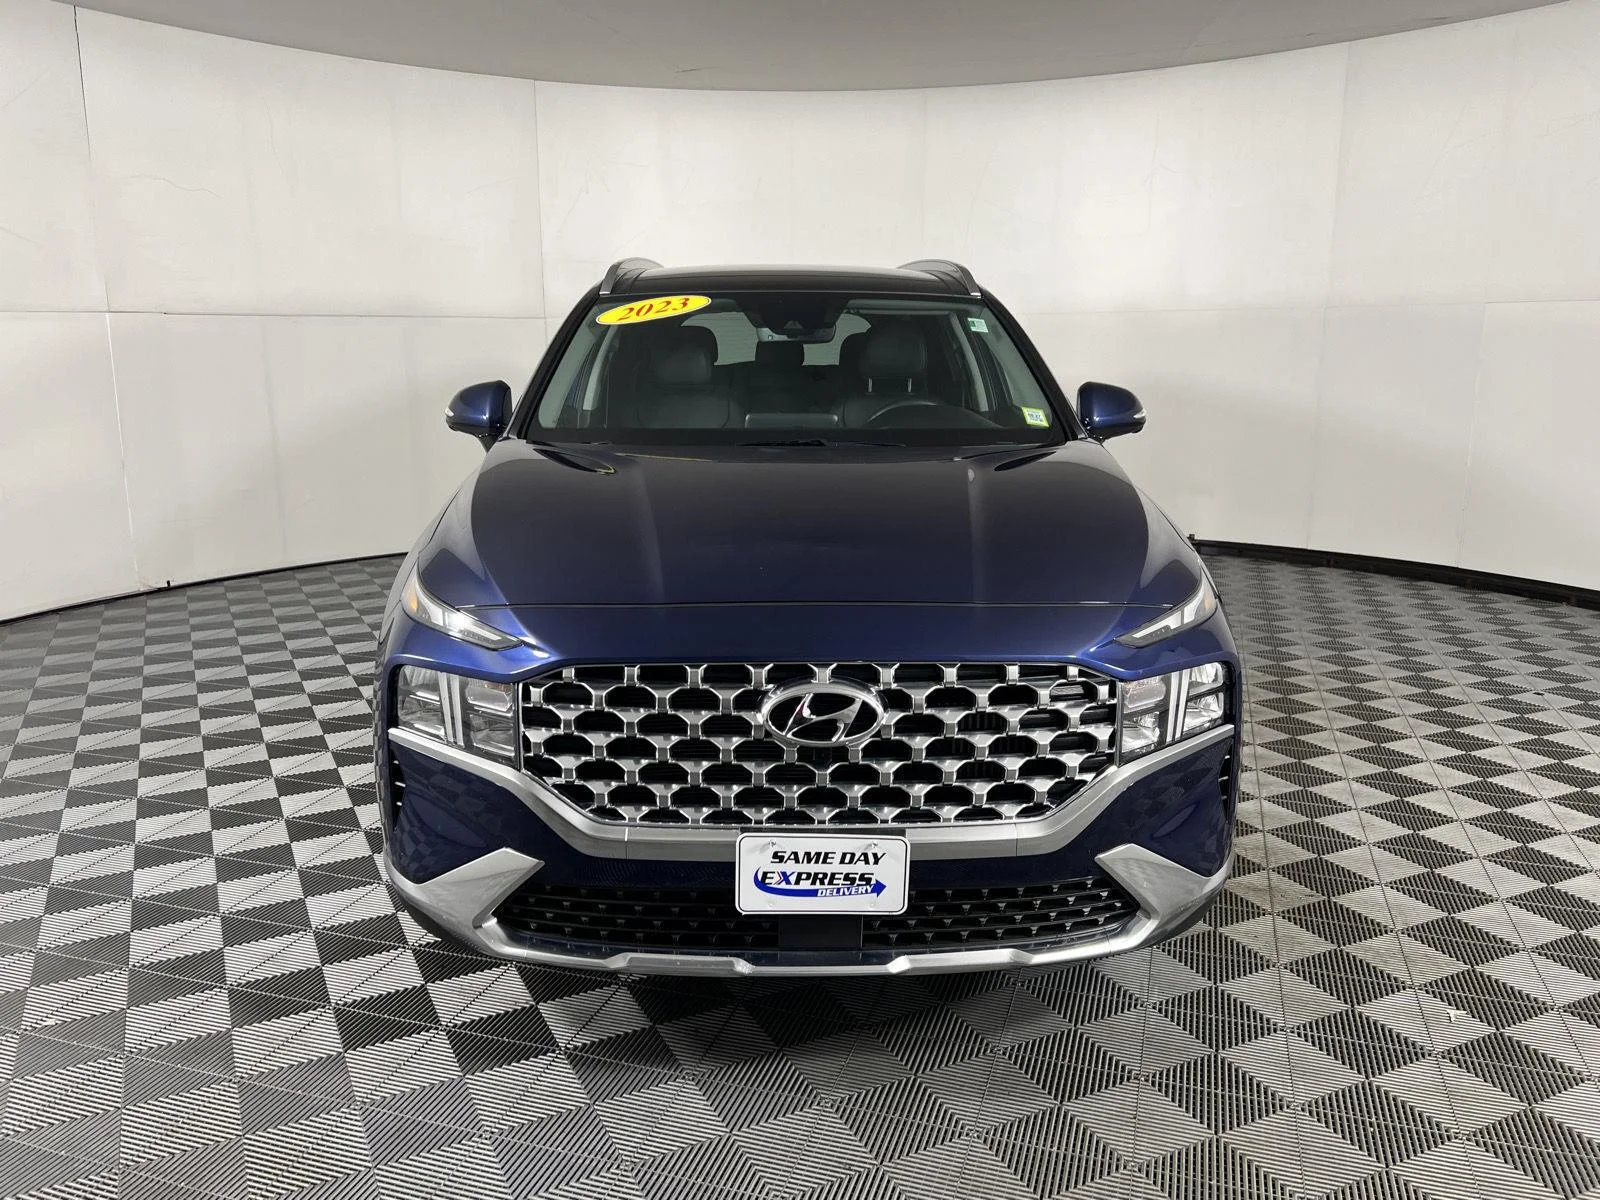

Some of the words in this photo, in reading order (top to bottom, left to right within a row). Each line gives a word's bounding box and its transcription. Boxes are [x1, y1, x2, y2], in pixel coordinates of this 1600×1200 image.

[616, 297, 690, 321] 2023
[770, 850, 836, 865] SAME
[839, 851, 886, 866] DAY
[760, 871, 874, 886] EXPRESS
[817, 885, 874, 897] DELIVERY
